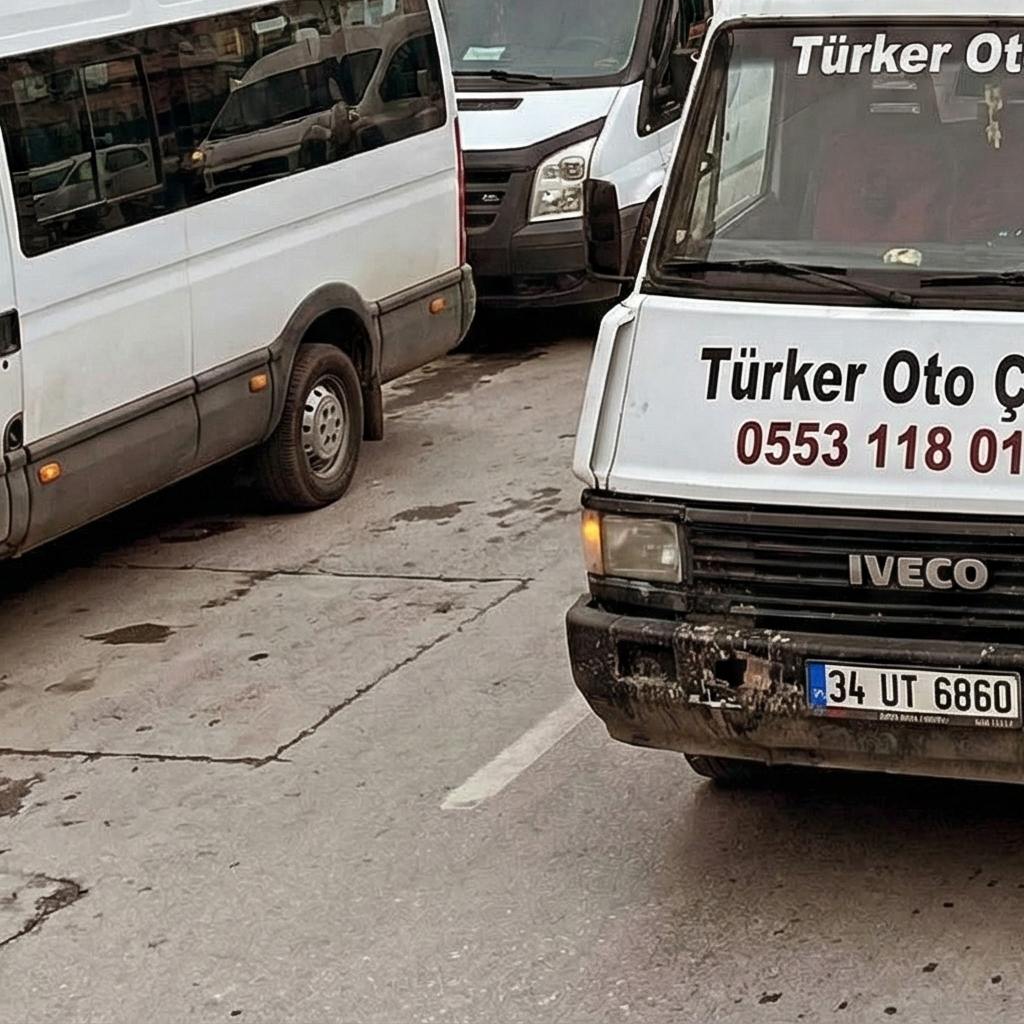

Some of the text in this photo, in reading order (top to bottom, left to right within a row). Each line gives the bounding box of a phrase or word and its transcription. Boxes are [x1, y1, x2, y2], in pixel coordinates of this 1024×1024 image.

[791, 33, 953, 76] Türker
[701, 347, 867, 402] Türker
[883, 349, 974, 407] Oto
[736, 421, 848, 467] 0553
[868, 424, 952, 471] 118
[969, 428, 1022, 475] 01
[849, 554, 988, 590] IVECO
[828, 669, 1012, 714] 34 UT 6860
